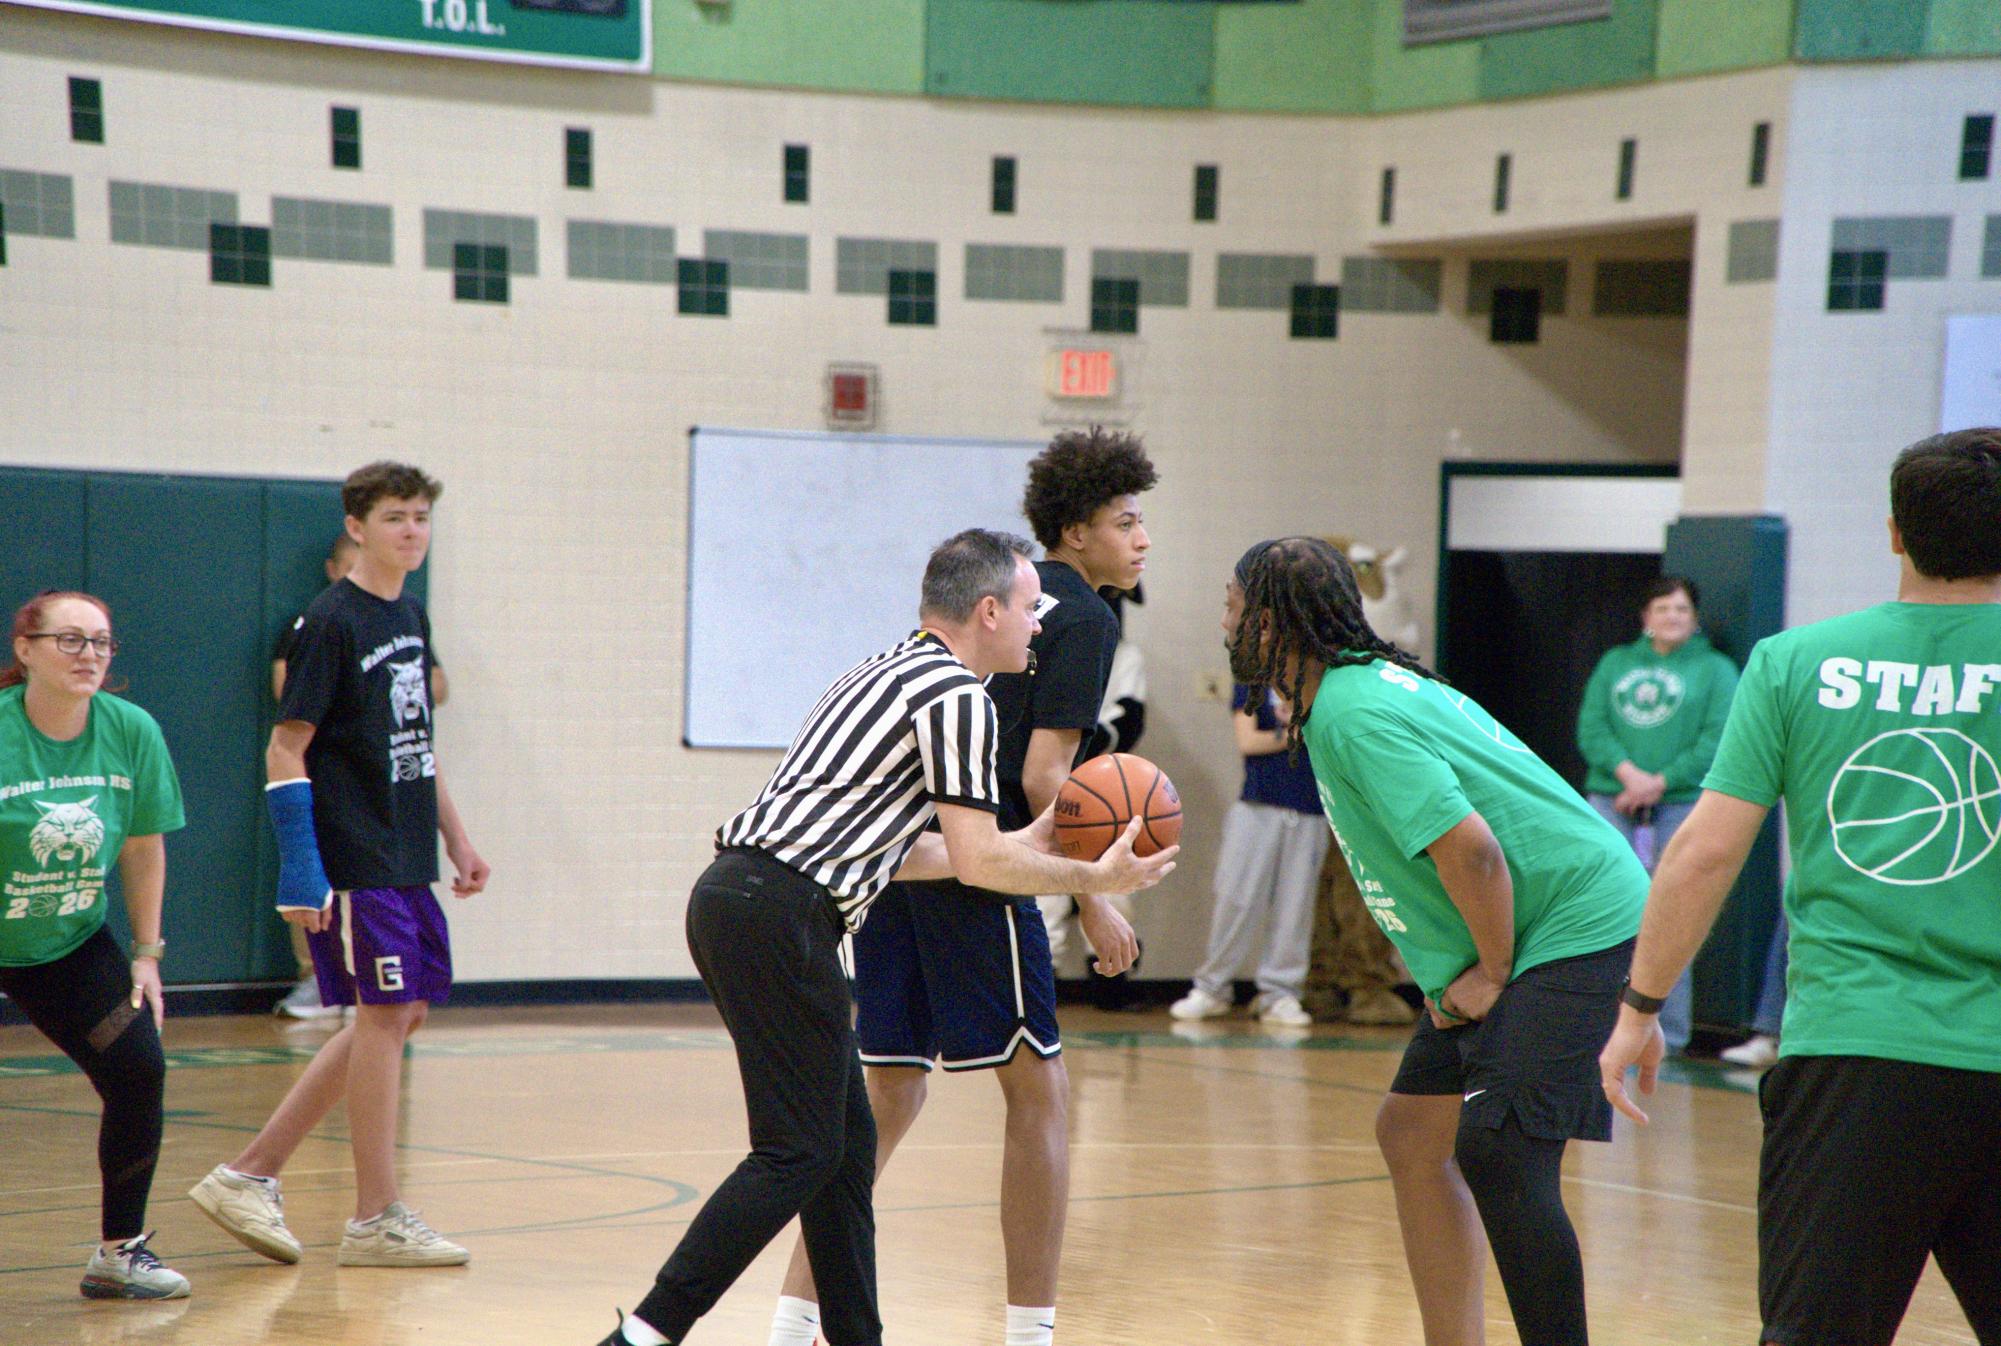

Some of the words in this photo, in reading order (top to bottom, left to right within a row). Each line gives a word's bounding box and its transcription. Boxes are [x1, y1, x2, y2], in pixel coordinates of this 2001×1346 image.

[420, 0, 506, 35] T.O.L.
[1060, 350, 1110, 396] EXIT
[48, 775, 106, 789] Johnson
[109, 774, 132, 790] HS
[13, 871, 64, 883] Student
[4, 881, 74, 896] Basketball
